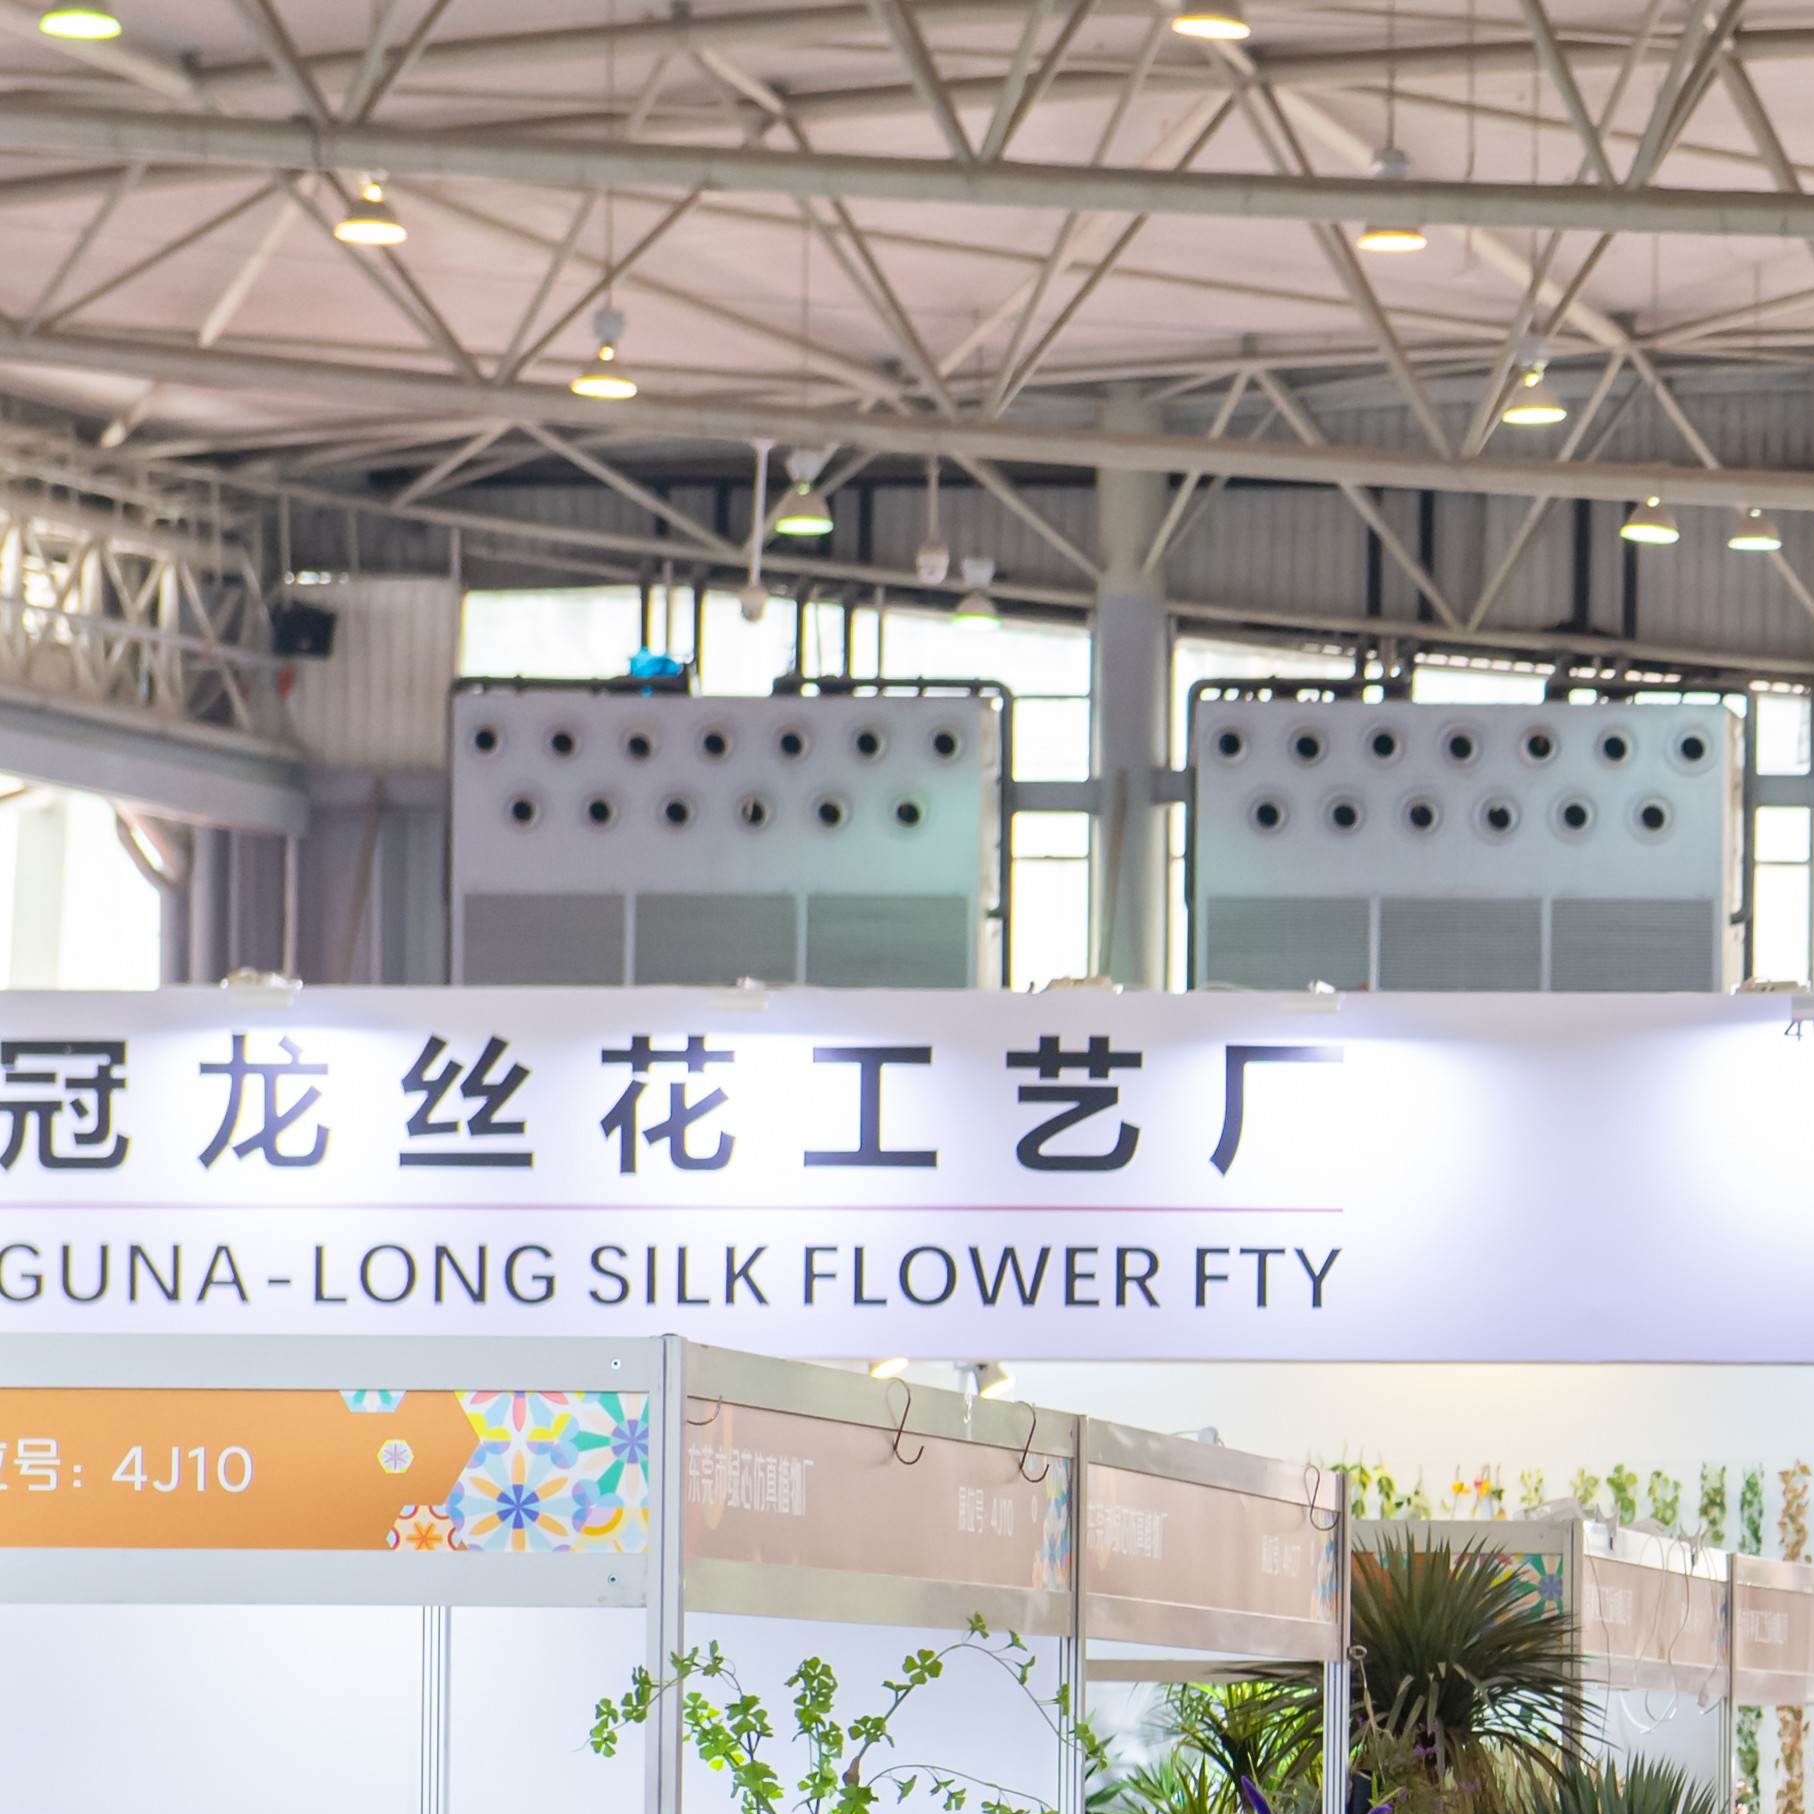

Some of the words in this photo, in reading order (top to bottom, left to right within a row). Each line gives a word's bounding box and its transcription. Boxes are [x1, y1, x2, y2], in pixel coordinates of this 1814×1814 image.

[0, 1032, 1343, 1174] 冠龙丝花工艺厂
[0, 1241, 557, 1306] GUNA-LONG
[588, 1242, 767, 1306] SILK
[803, 1243, 1160, 1309] FLOWER
[1195, 1246, 1342, 1309] FTY
[0, 1437, 254, 1494] 号：4J10
